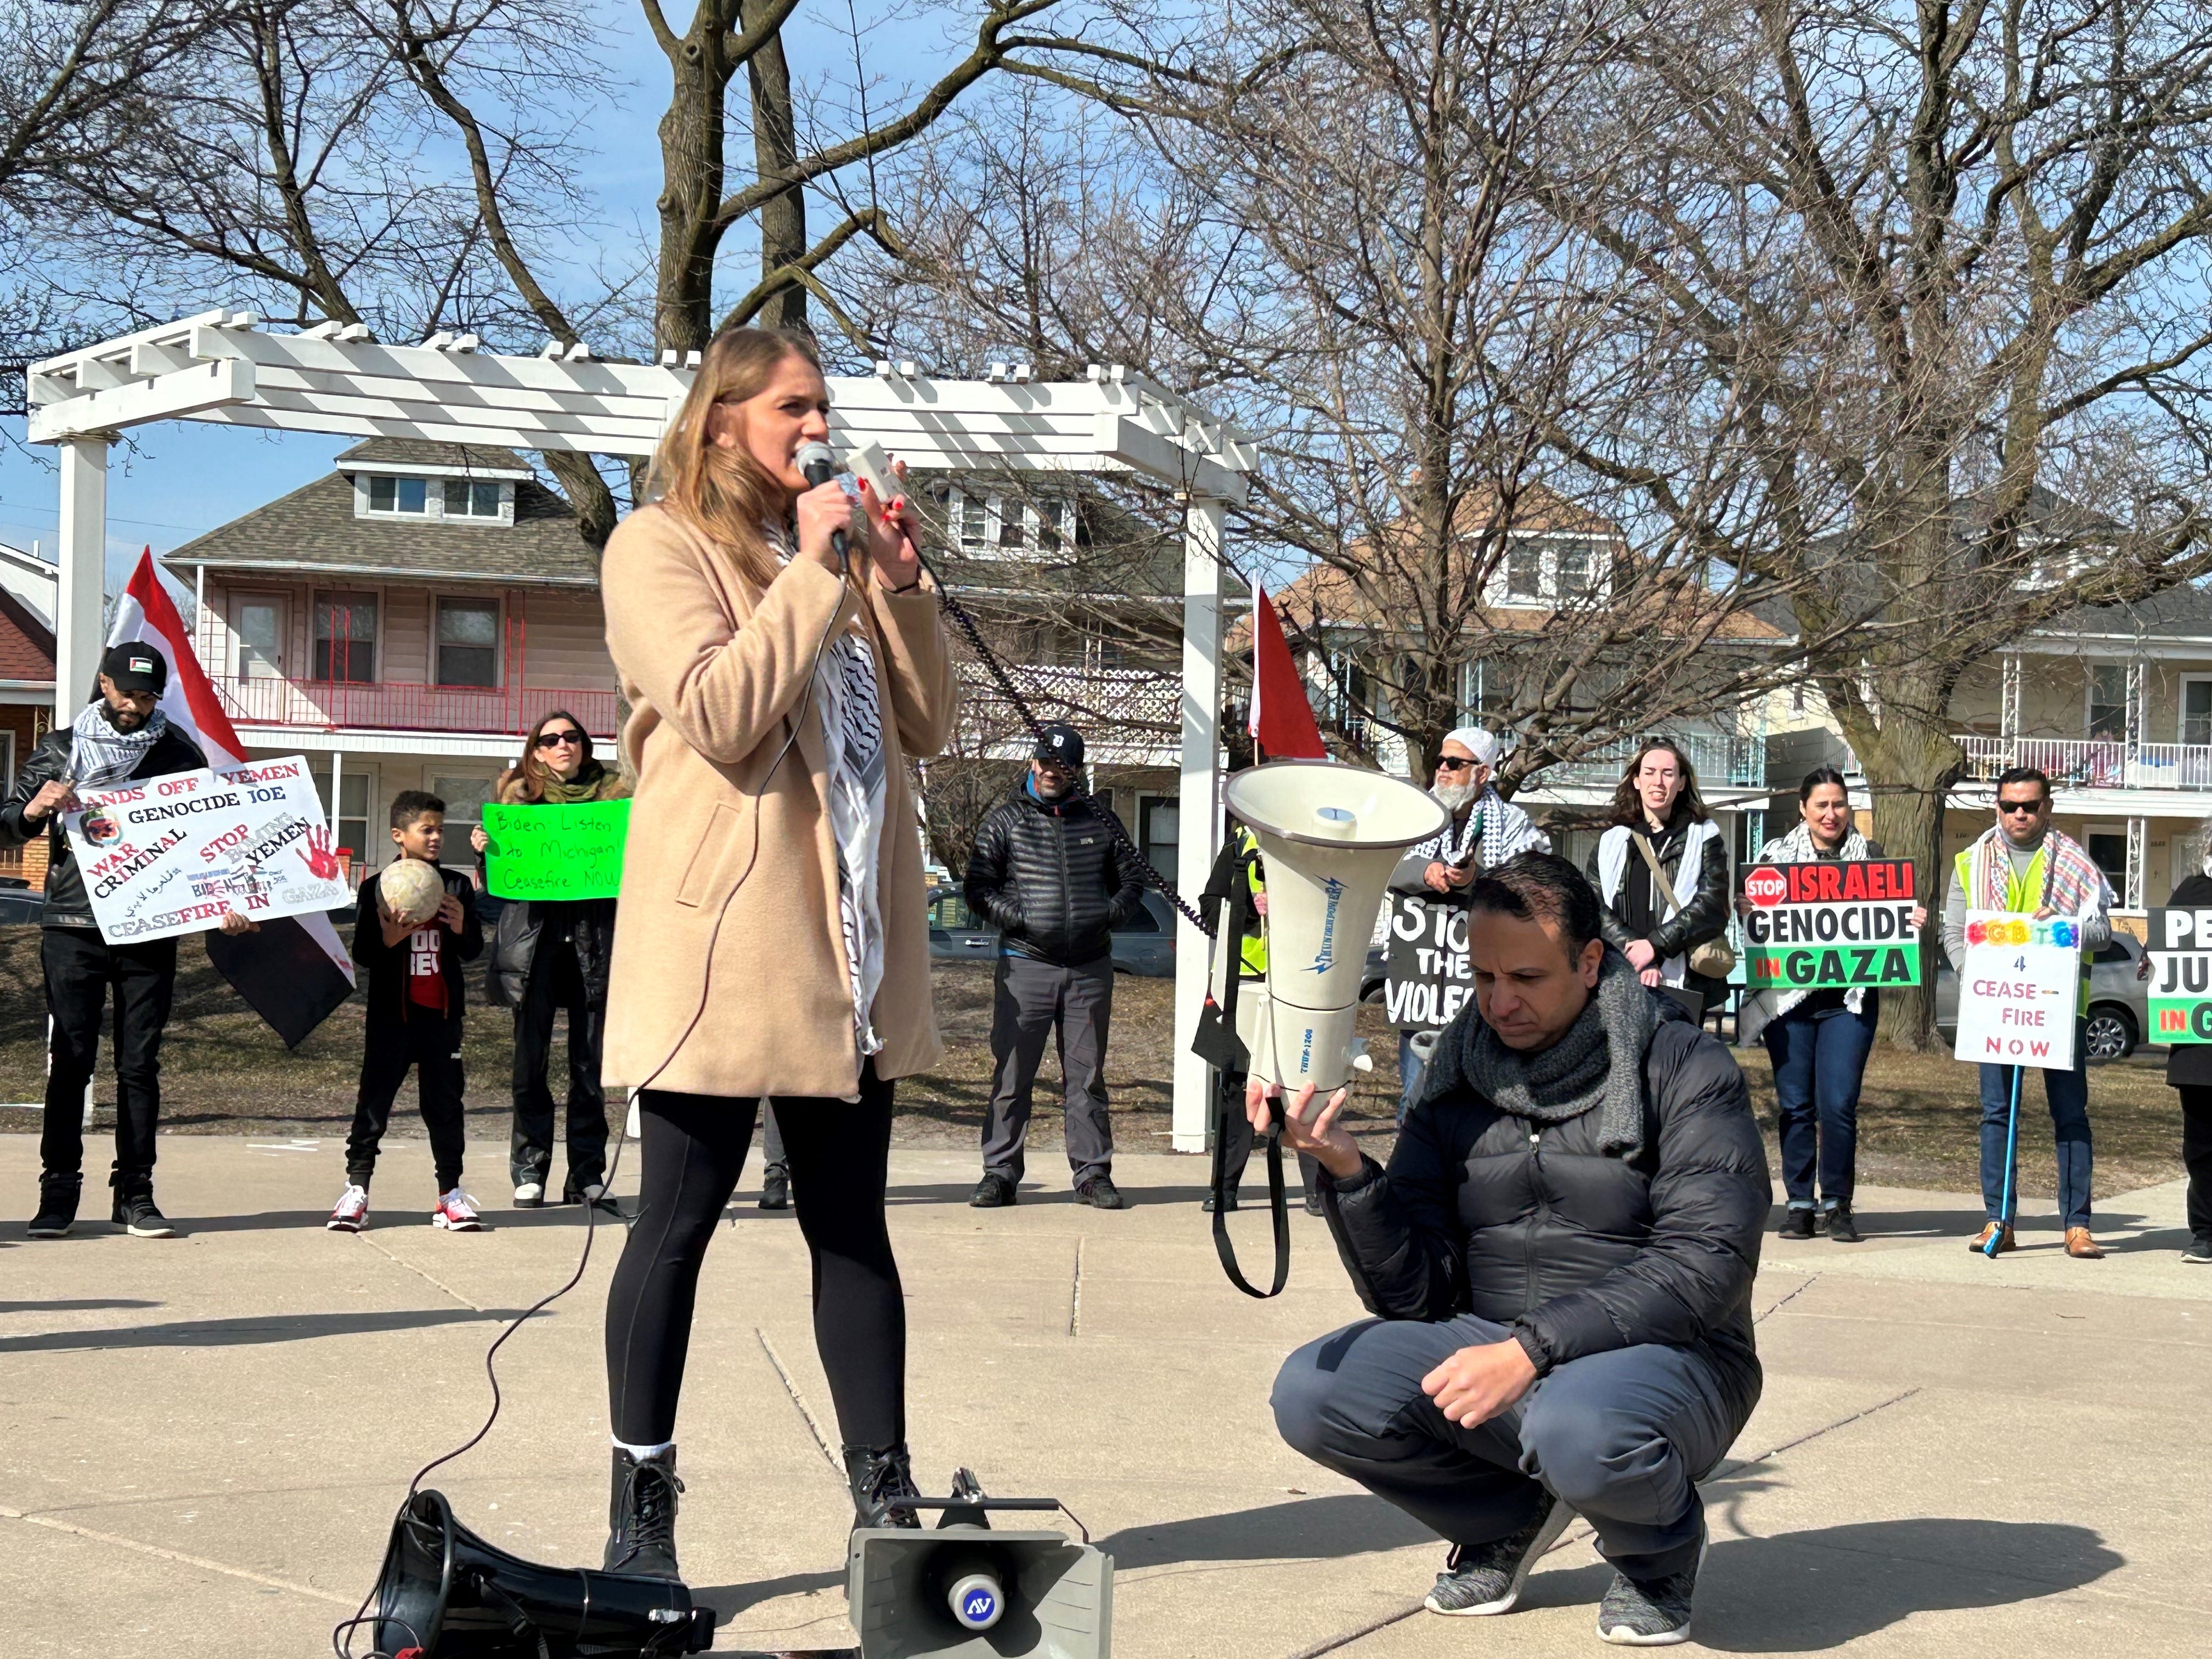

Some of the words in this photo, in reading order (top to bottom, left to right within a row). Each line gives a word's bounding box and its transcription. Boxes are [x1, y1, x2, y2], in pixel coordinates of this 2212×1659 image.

[157, 777, 199, 797] OFF
[220, 763, 300, 786] YEMEN
[128, 793, 240, 823] GENOCIDE
[247, 786, 286, 803] JOE
[561, 810, 611, 832] Listen
[199, 824, 249, 864] STOP
[245, 817, 312, 865] YEMEN
[506, 843, 523, 857] to
[87, 843, 139, 878] WAR
[94, 828, 188, 899] CRIMINAL
[1747, 879, 1785, 896] STOP
[1789, 862, 1914, 901] ISRAELI
[108, 900, 231, 938] CEASEFIRE
[245, 893, 270, 910] IN
[281, 882, 340, 905] GAZA
[1747, 906, 1914, 944] GENOCIDE
[1415, 948, 1472, 979] THE
[1756, 957, 1781, 978] IN
[1786, 948, 1912, 984] GAZA
[2013, 956, 2026, 972] 4
[2002, 1008, 2045, 1026] FIRE
[2159, 1009, 2187, 1031] IN
[1986, 1036, 2050, 1057] NOW
